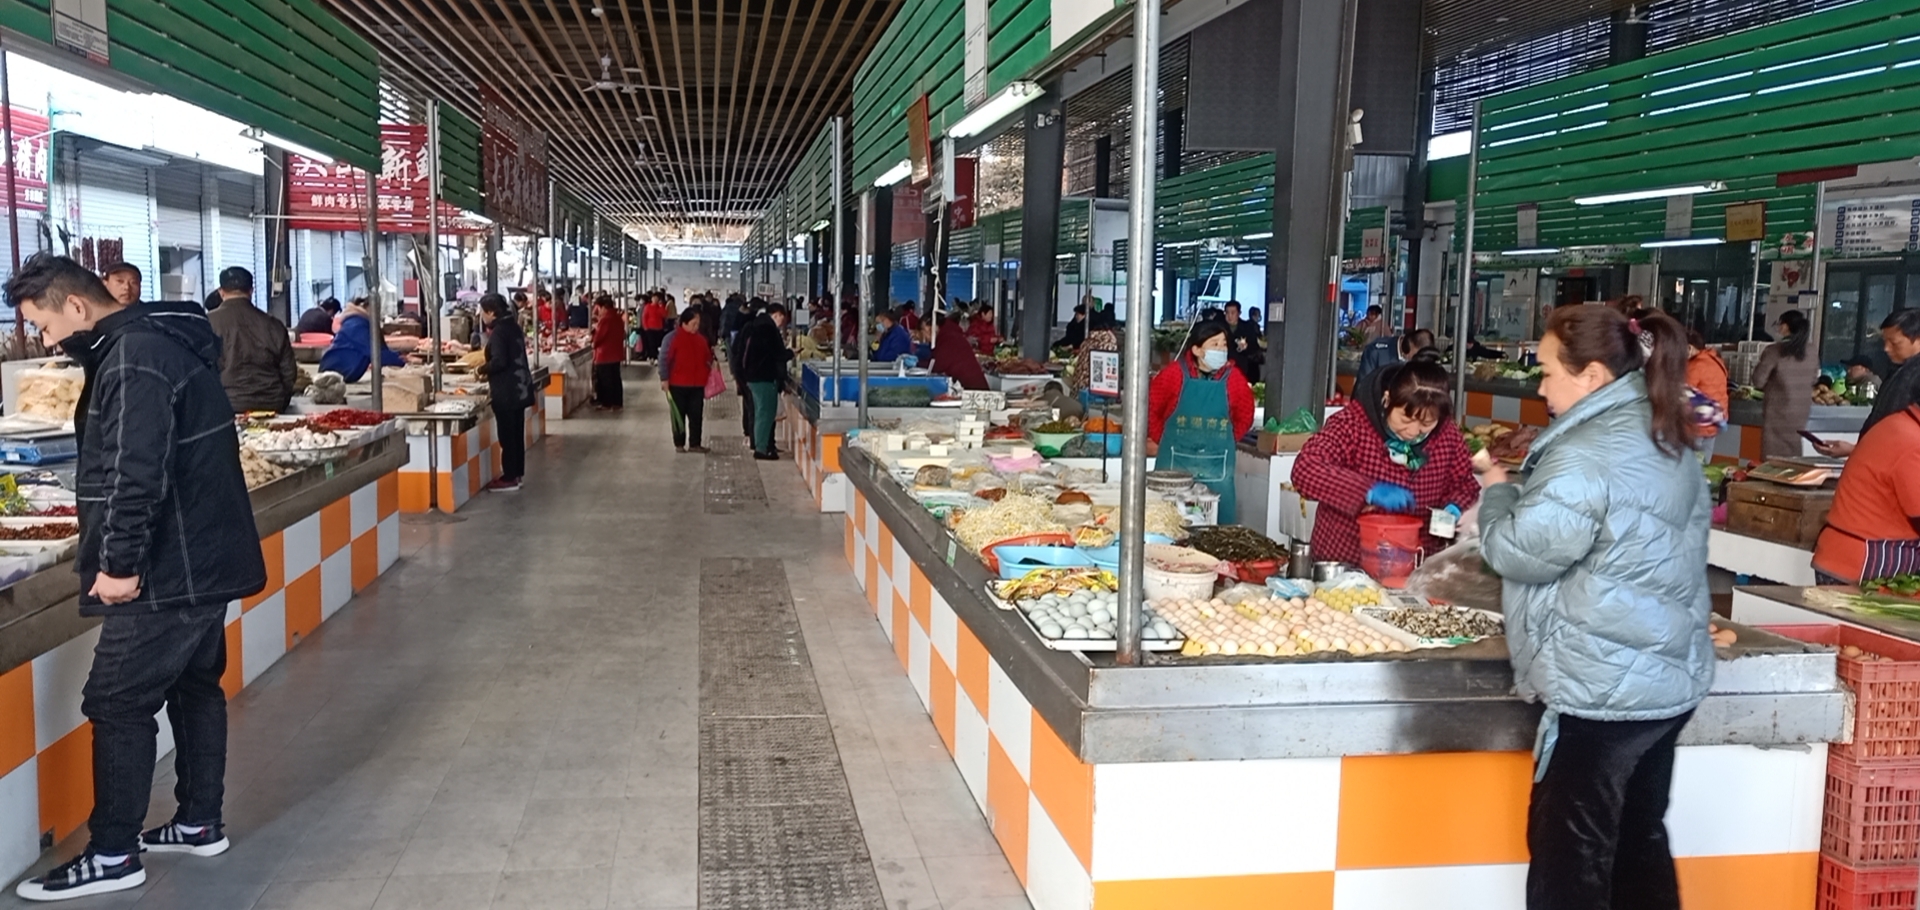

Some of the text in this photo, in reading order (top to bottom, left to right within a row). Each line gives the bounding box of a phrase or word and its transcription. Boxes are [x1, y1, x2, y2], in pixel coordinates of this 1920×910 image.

[311, 194, 414, 211] 鲜肉专卖发零售
